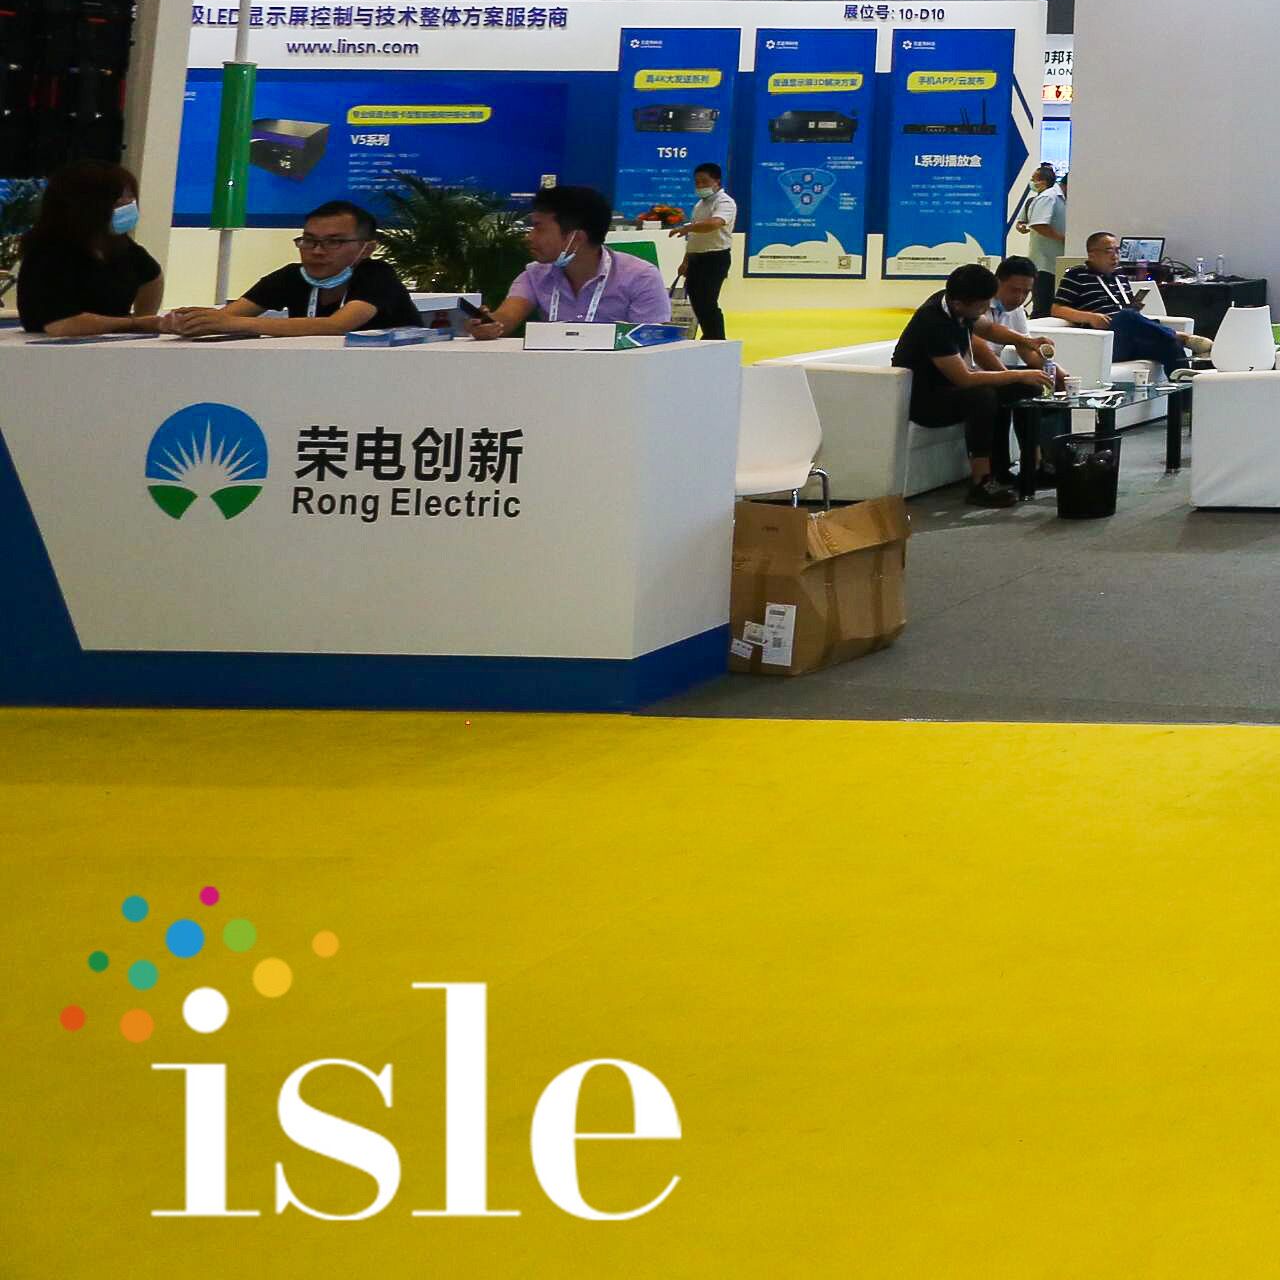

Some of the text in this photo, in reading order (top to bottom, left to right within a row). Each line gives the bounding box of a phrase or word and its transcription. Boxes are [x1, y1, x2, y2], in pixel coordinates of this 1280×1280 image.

[287, 39, 419, 55] www.linsn.com
[657, 147, 688, 158] TS16
[914, 154, 982, 168] L系列播放盒
[295, 425, 524, 484] 荣电创新
[292, 486, 520, 523] Rong Electric
